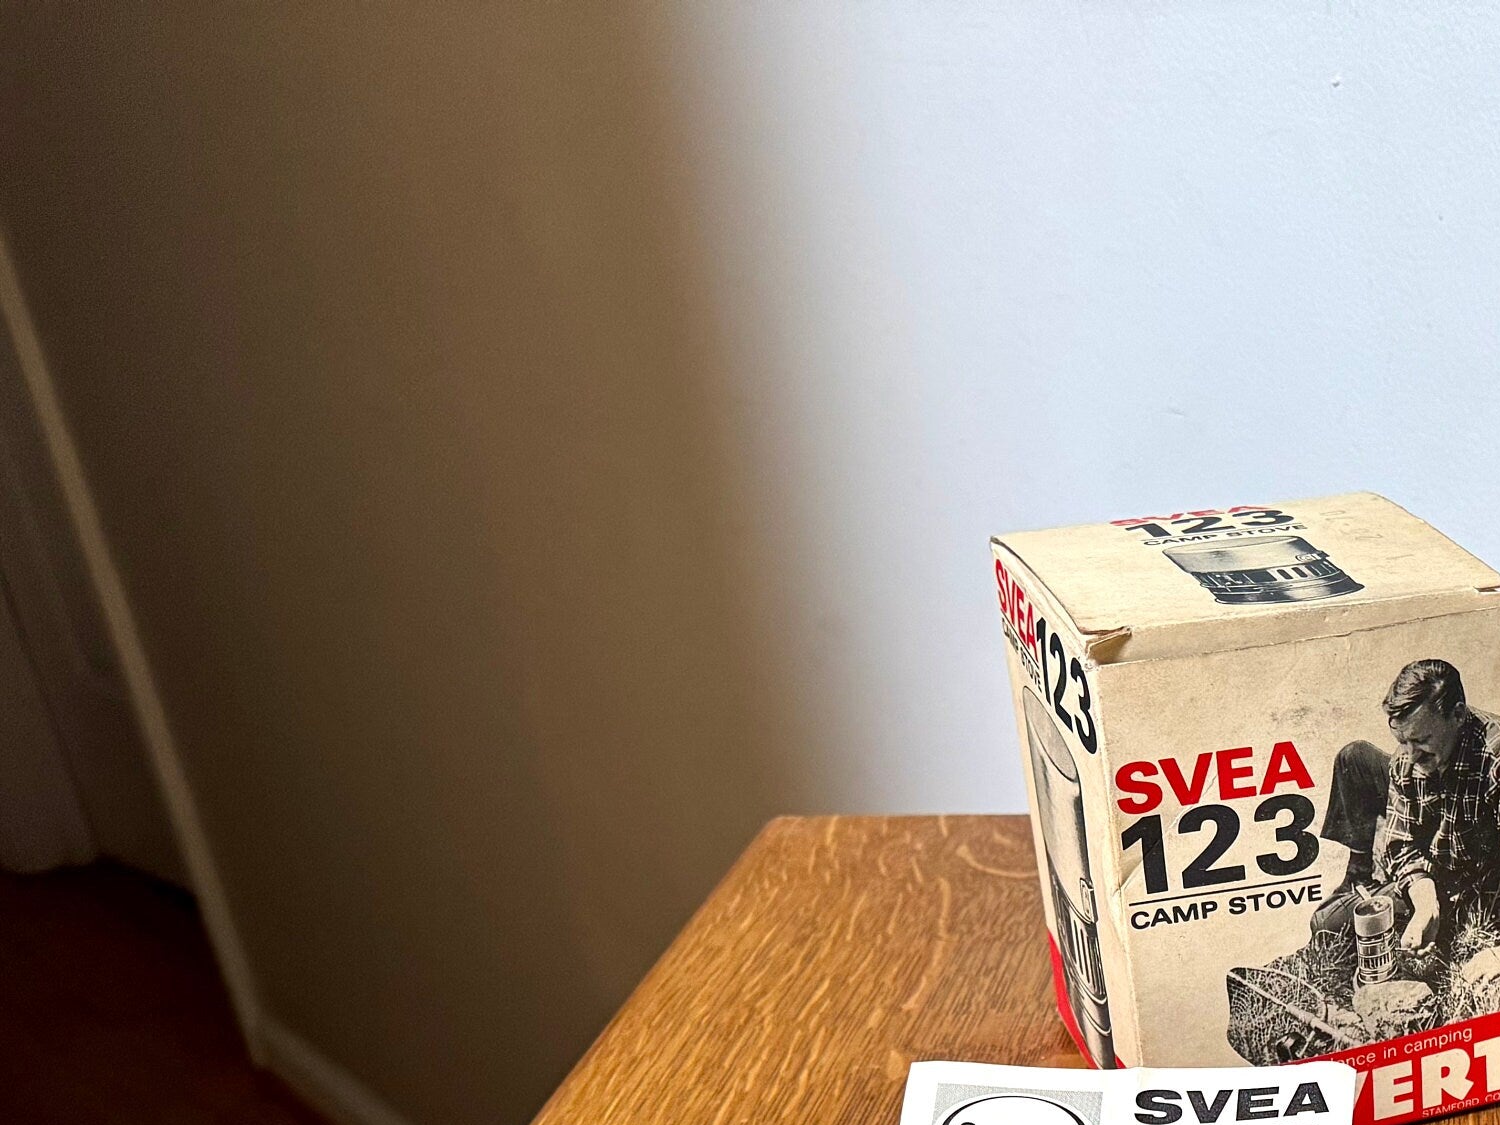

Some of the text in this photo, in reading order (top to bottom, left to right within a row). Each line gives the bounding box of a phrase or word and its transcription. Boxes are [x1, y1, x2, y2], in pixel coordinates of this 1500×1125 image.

[1125, 510, 1294, 538] 123
[1143, 524, 1308, 546] CAMP STOVE
[995, 558, 1039, 662] SVEA
[1036, 616, 1098, 755] 123
[1114, 741, 1315, 815] SVEA
[1120, 794, 1321, 896] 123
[1129, 884, 1323, 932] CAMP STOVE
[1330, 1027, 1473, 1067] nce in camping
[1134, 1082, 1329, 1125] SVEA
[1422, 1097, 1480, 1118] STAMFORD
